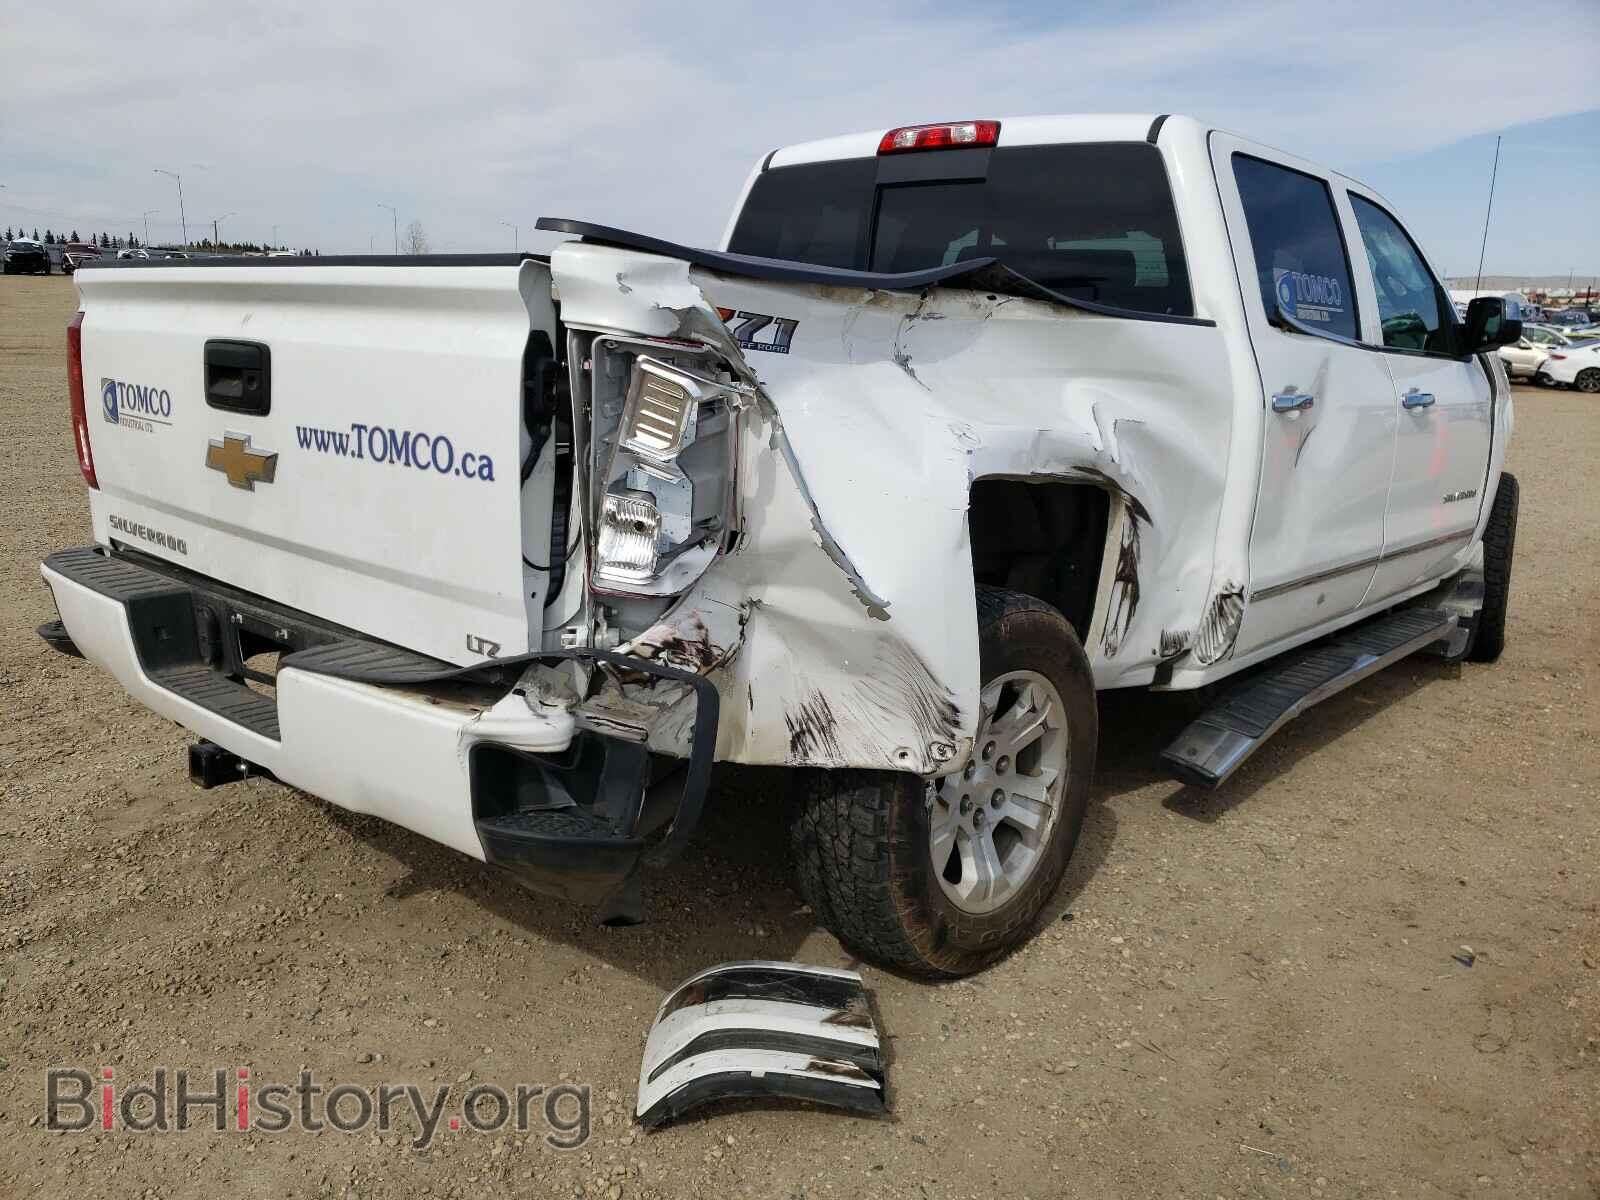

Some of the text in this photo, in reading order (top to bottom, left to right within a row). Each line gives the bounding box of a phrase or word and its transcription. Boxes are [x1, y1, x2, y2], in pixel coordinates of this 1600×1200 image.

[1292, 271, 1342, 306] TOMCO
[757, 342, 788, 354] ROAD
[117, 381, 171, 417] TOMCO
[296, 423, 495, 482] www.TOMCO.ca
[109, 514, 188, 555] SILVERADO
[466, 633, 501, 659] LTZ
